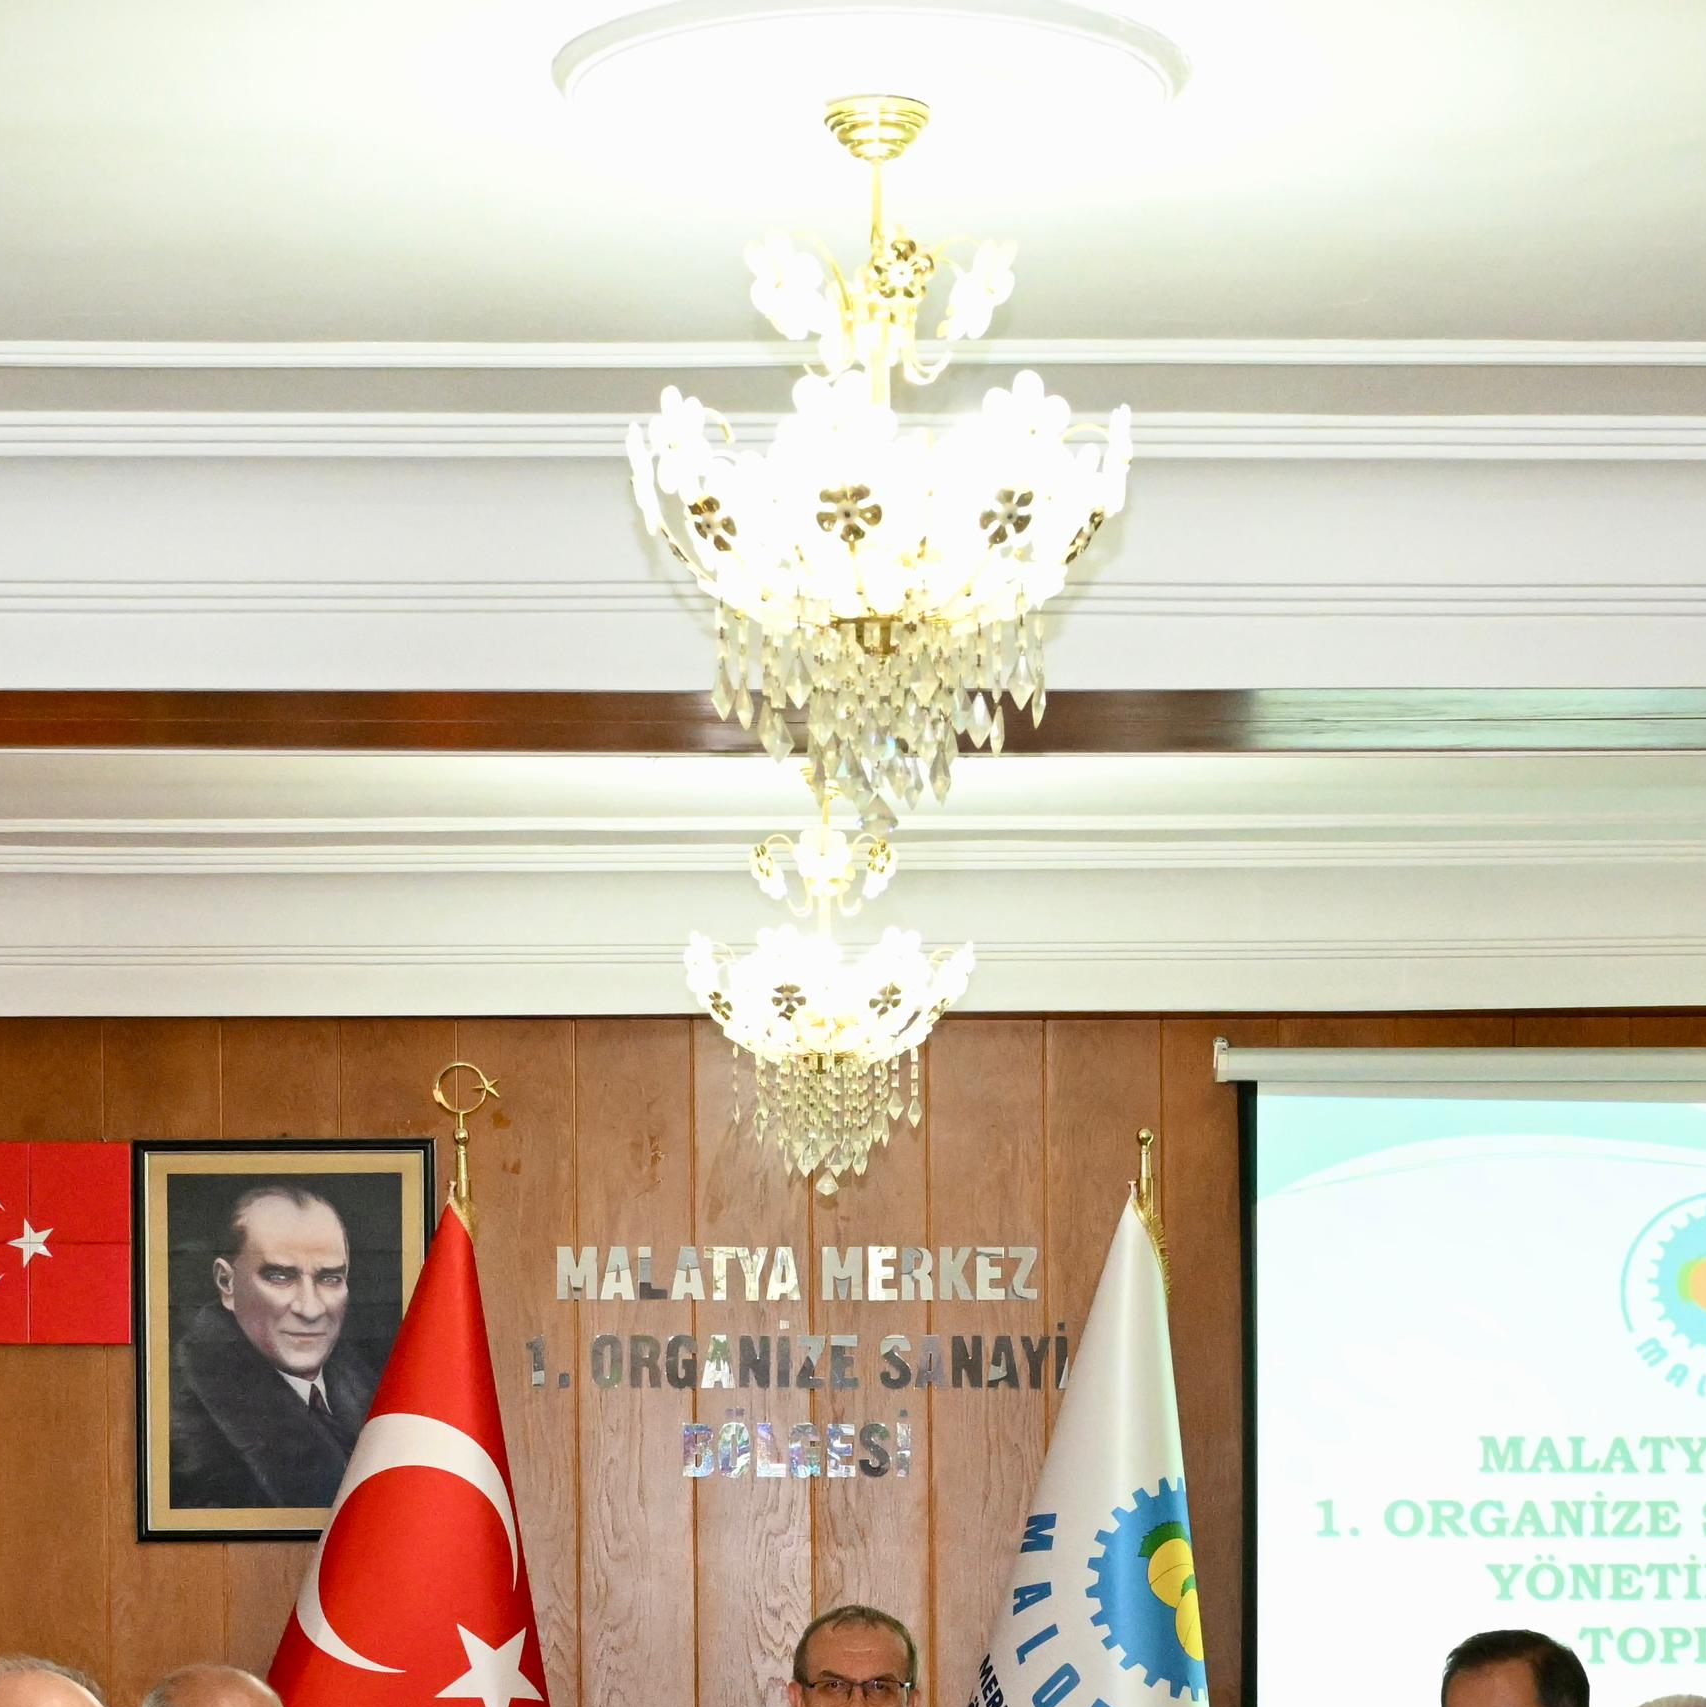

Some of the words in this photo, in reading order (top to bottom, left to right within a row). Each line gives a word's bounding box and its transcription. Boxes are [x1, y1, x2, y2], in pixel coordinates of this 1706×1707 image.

[556, 1245, 800, 1301] MALATYA
[822, 1245, 1038, 1300] MERKEZ
[526, 1333, 570, 1389] 1.
[592, 1319, 859, 1389] ORGANİZE
[879, 1321, 1070, 1389] SANAYİ
[681, 1408, 912, 1478] BÖLGESİ
[1317, 1500, 1361, 1538] 1.
[1384, 1491, 1683, 1539] ORGANİZE
